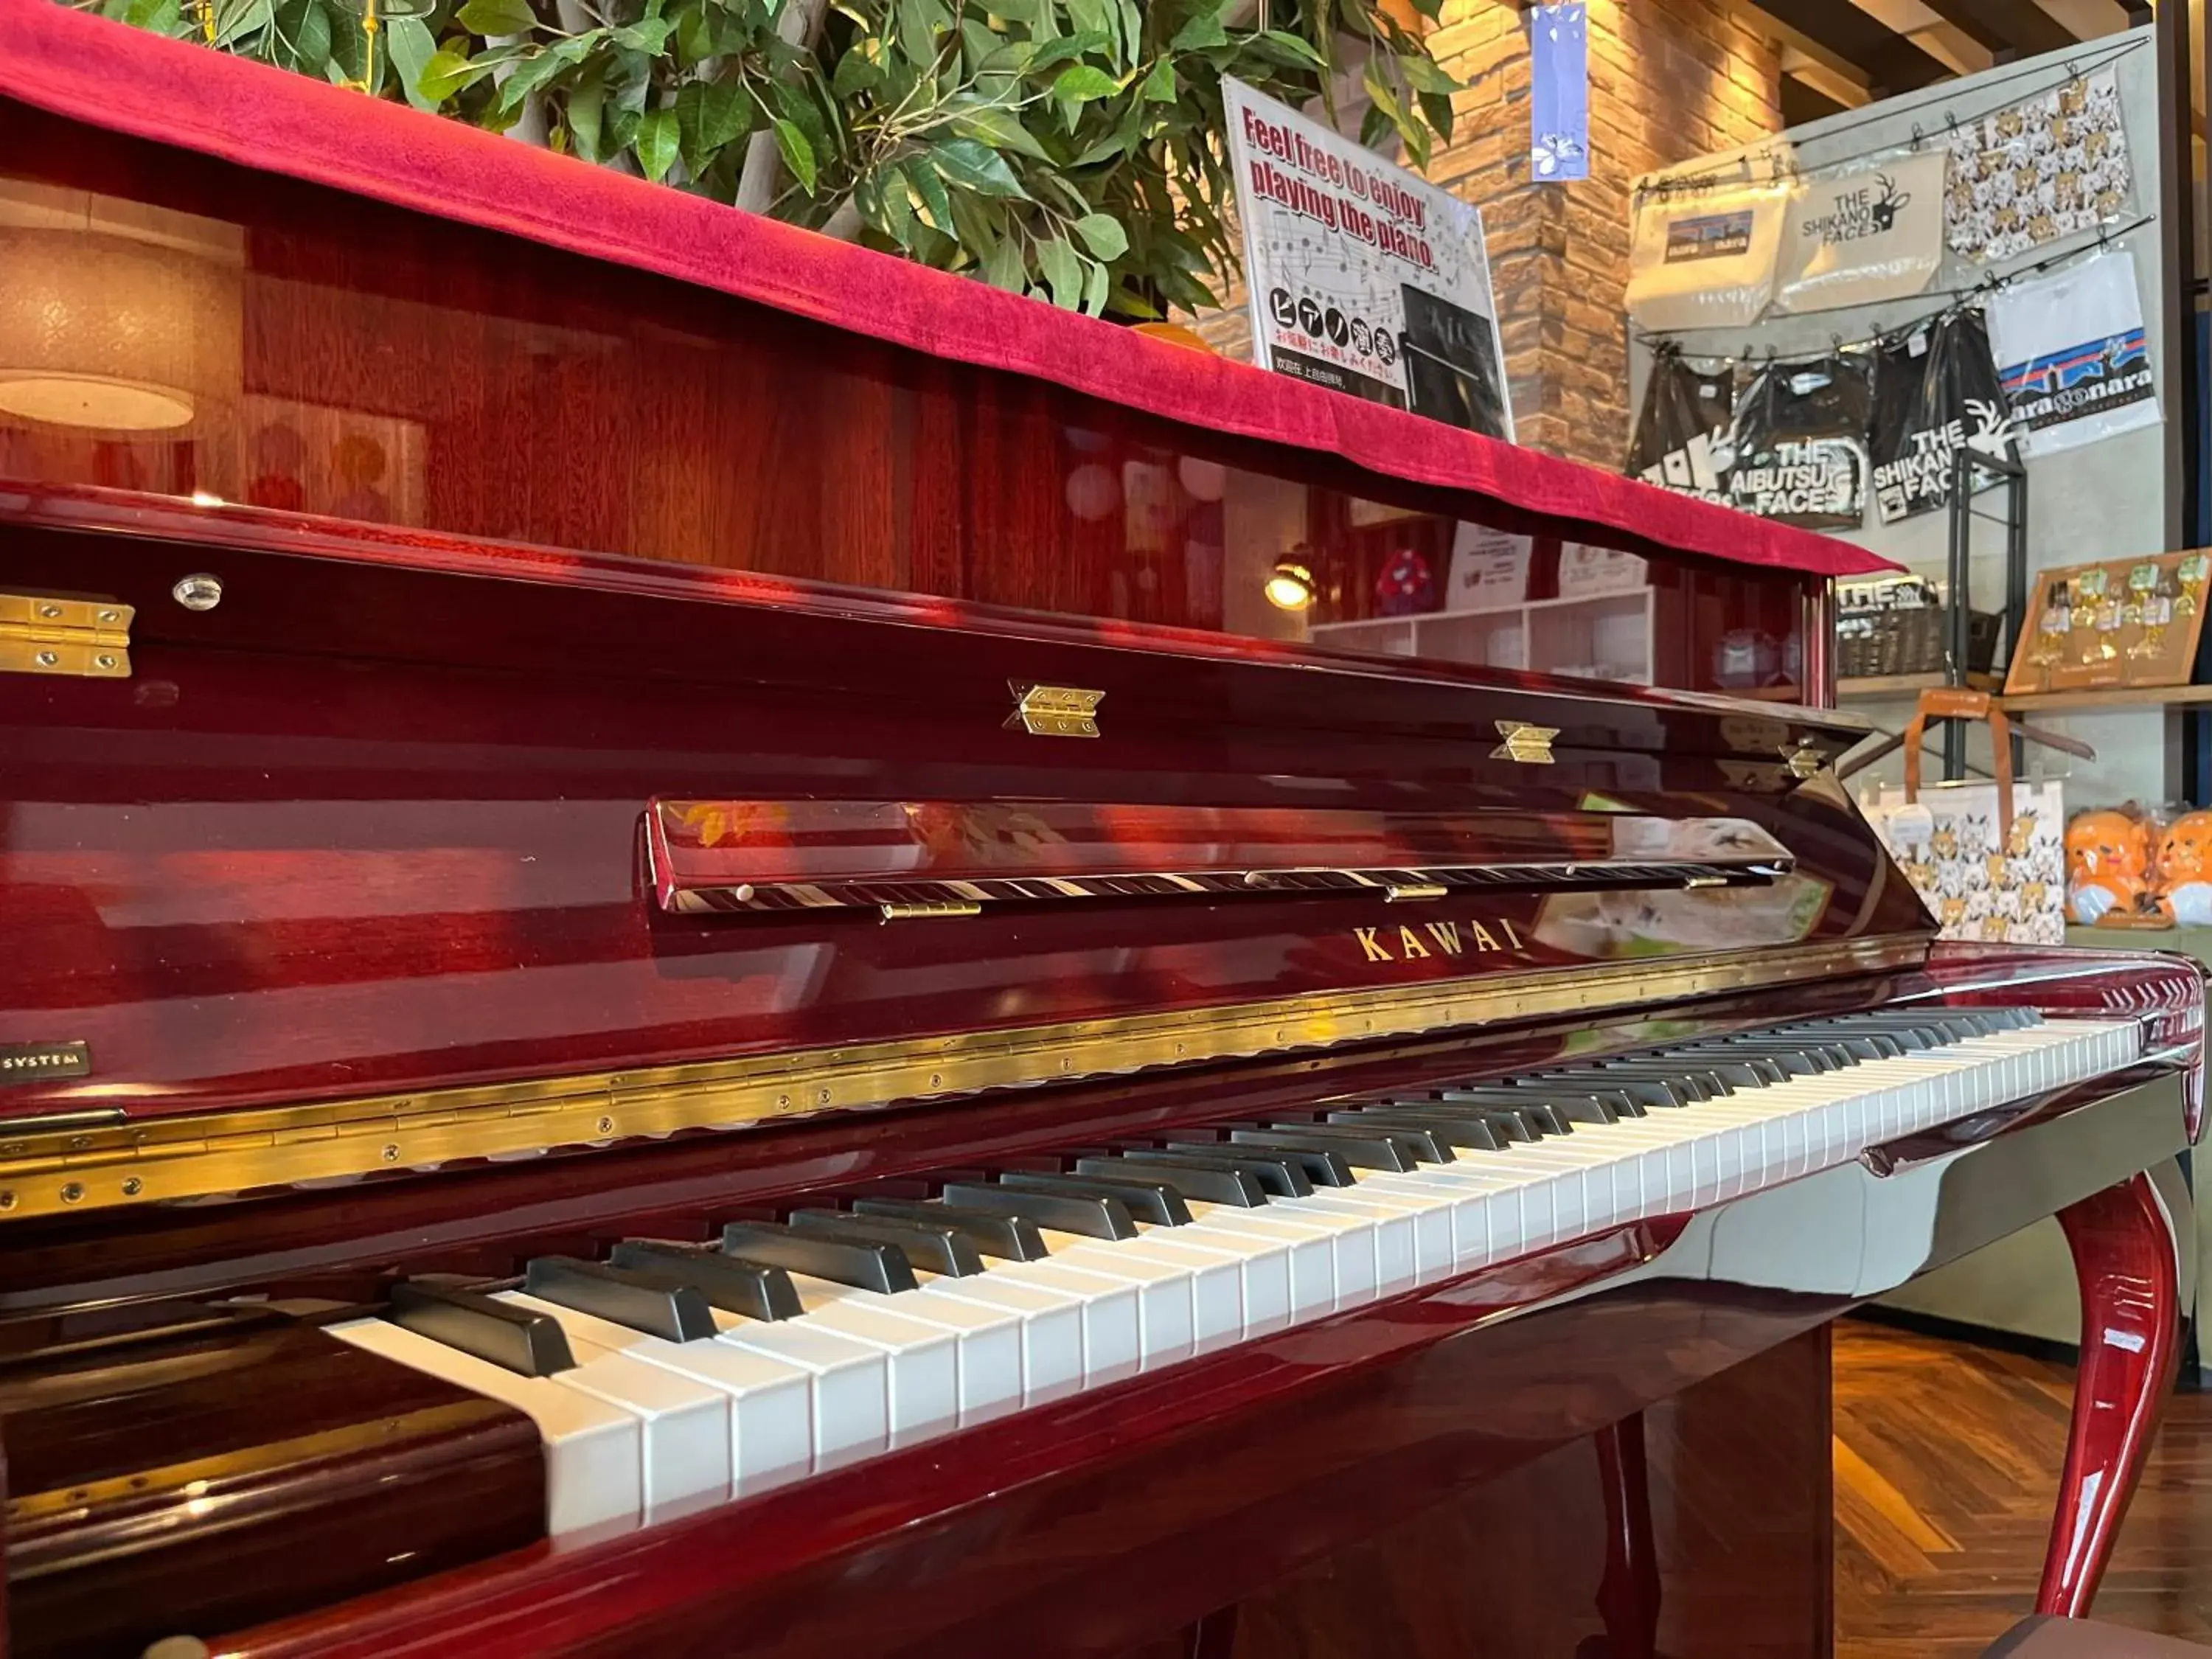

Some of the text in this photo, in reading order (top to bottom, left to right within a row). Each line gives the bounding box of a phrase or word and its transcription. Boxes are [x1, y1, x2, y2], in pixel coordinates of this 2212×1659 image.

[1242, 105, 1425, 229] Feel free to enjoy
[1250, 160, 1338, 231] playing
[1338, 198, 1375, 244] the
[1834, 189, 1870, 212] THE
[1803, 206, 1871, 237] SHIKANO
[1911, 419, 1966, 454] THE
[1775, 442, 1830, 465] THE
[1873, 447, 1952, 489] SHIKAN
[1731, 465, 1826, 493] AIBUTSU
[1905, 468, 1952, 500] FAC
[1756, 490, 1826, 515] FACE
[1354, 918, 1523, 961] KAWAI
[3, 1054, 79, 1068] SYSTEM
